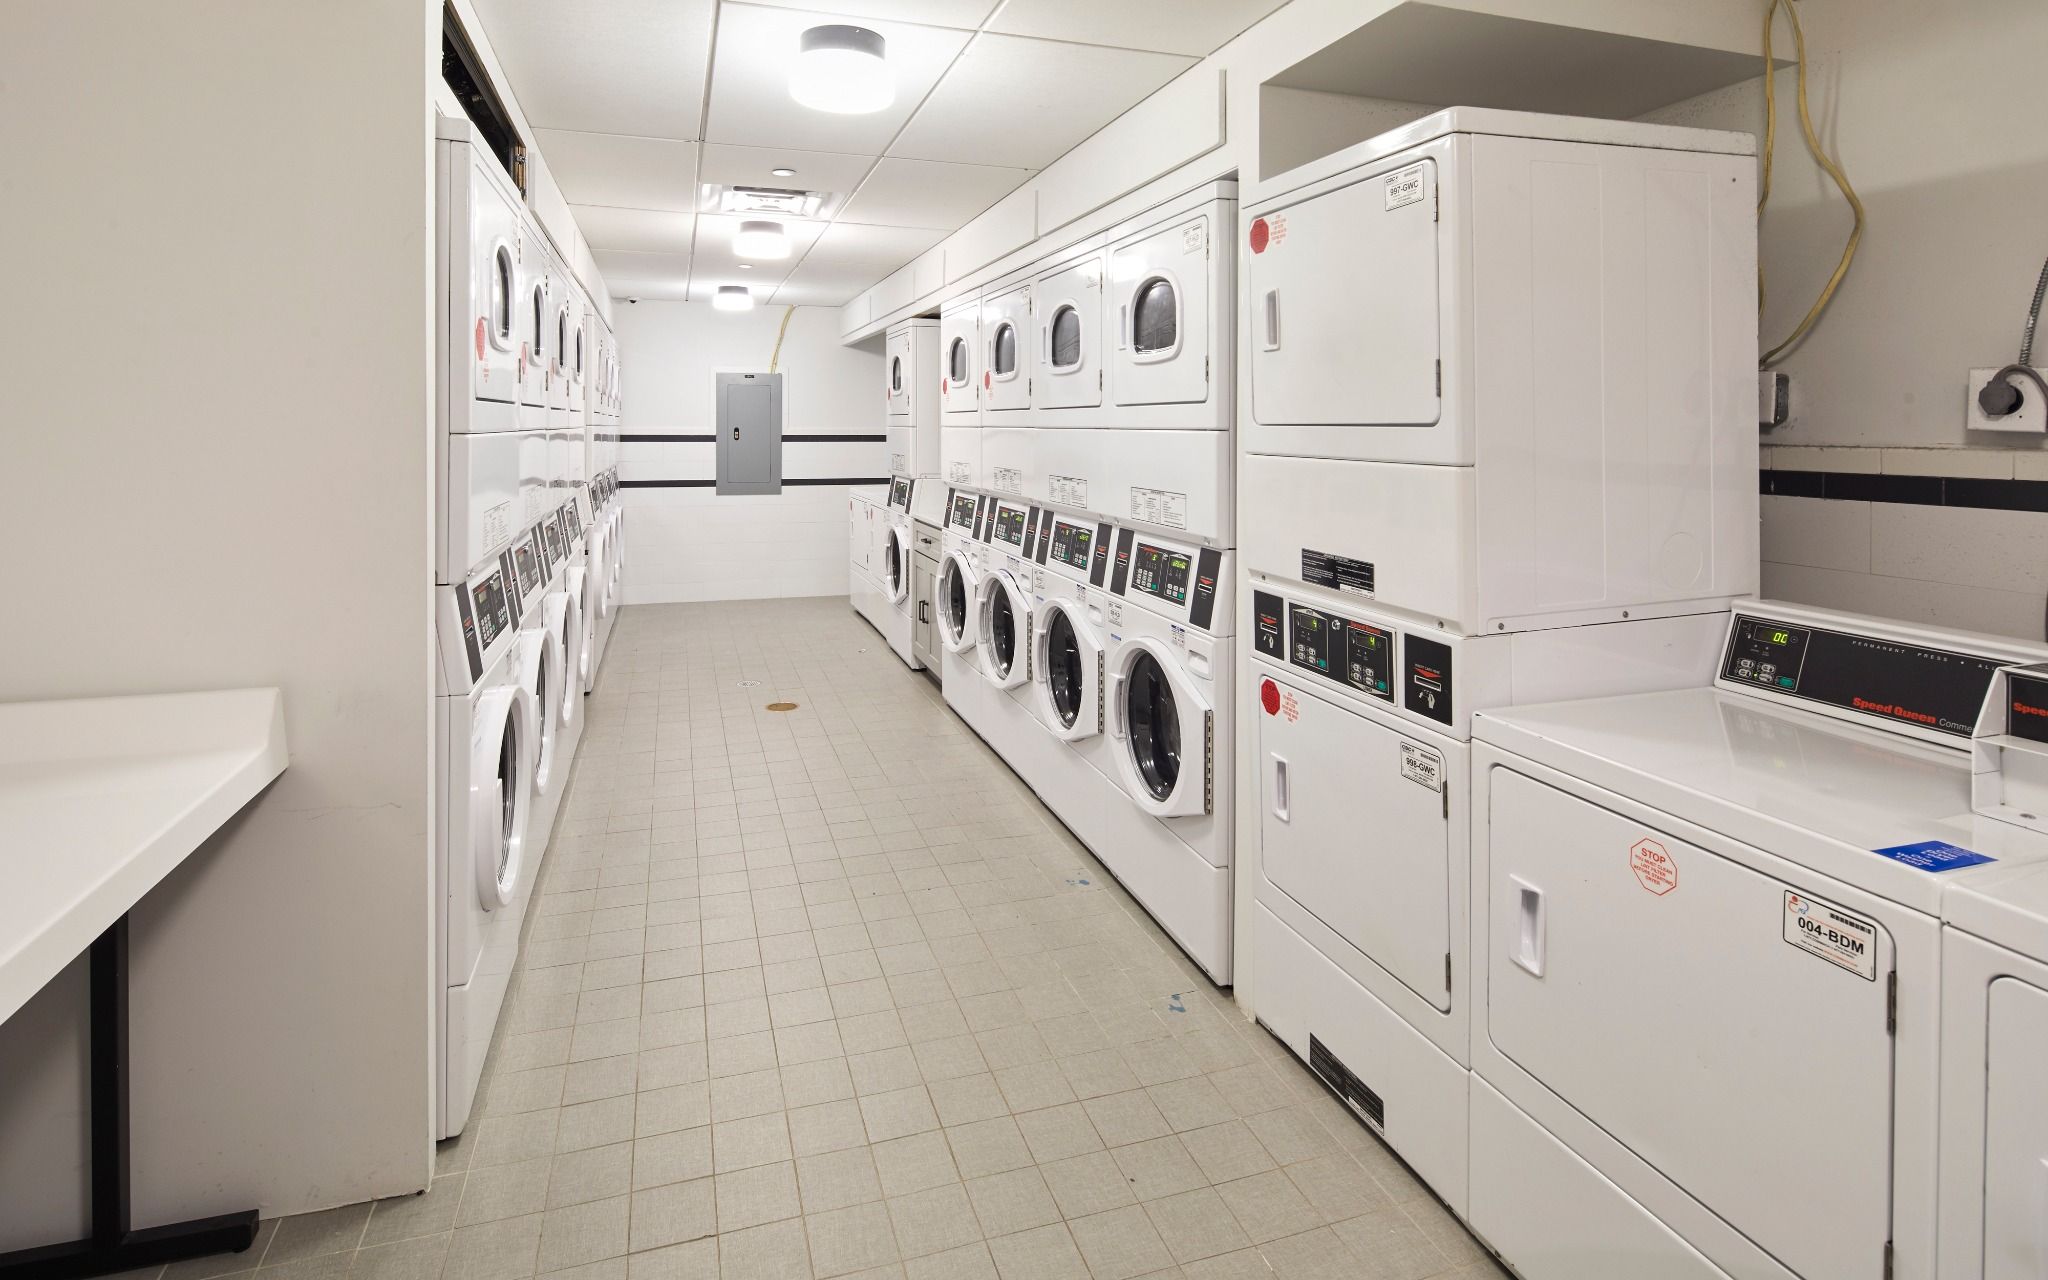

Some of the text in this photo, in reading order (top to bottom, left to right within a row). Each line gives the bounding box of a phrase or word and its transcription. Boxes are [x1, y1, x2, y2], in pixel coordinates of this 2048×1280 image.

[1390, 180, 1418, 196] 997-GWC
[1852, 640, 1905, 654] PERMANENT
[1917, 652, 1948, 662] PRESS
[1853, 697, 1974, 733] Speed Queen Comme
[2013, 702, 2048, 717] Spee
[1641, 847, 1666, 864] STOP
[1650, 866, 1666, 878] FILTER
[1651, 872, 1674, 887] STARTING
[1798, 916, 1864, 955] 004-BDM
